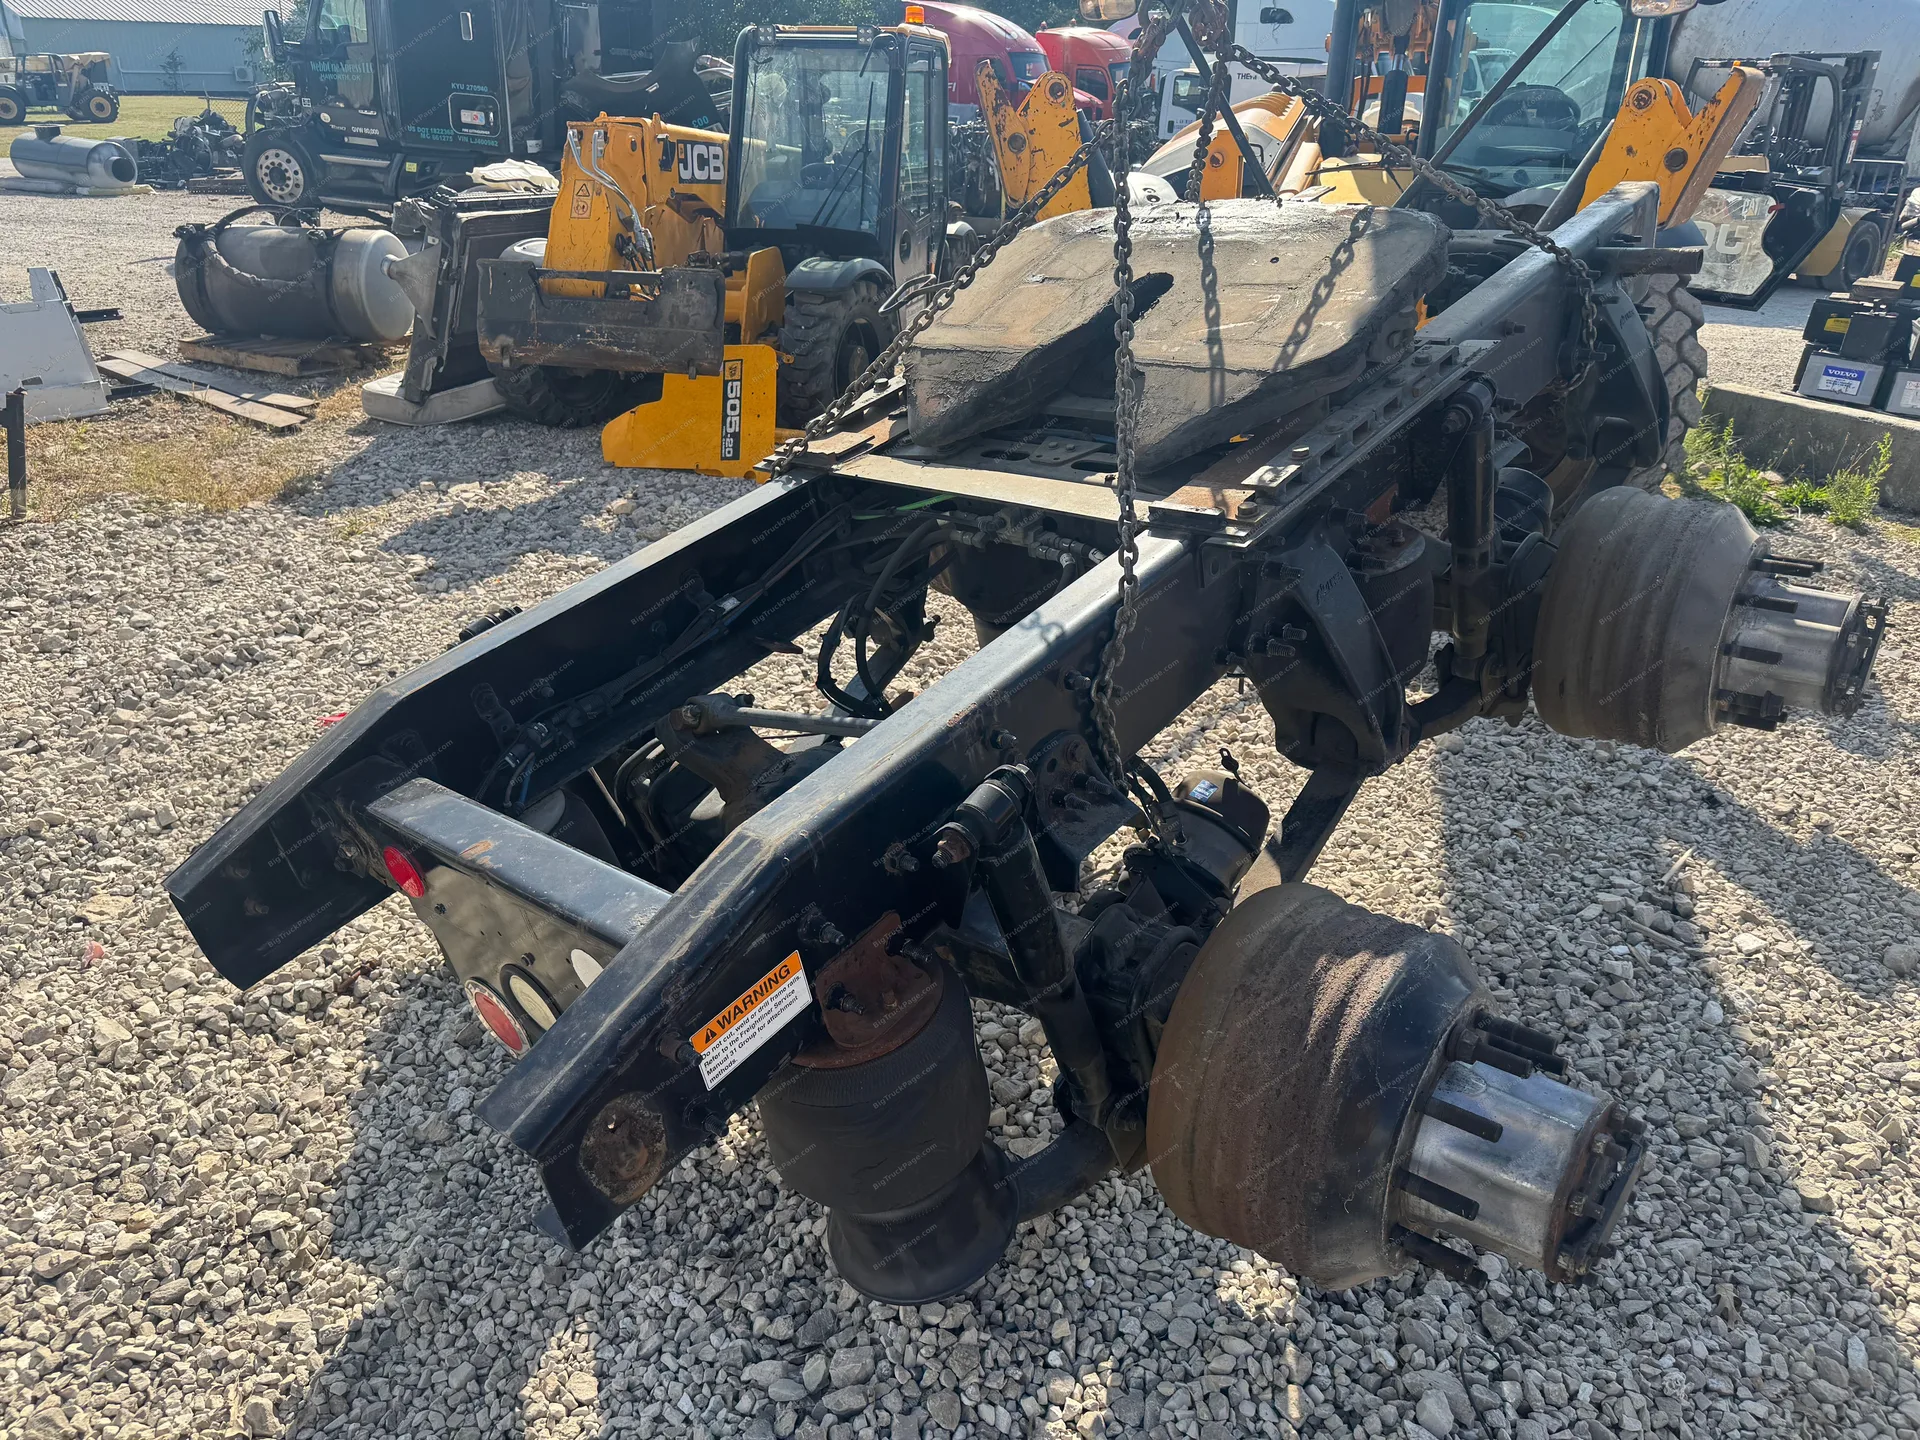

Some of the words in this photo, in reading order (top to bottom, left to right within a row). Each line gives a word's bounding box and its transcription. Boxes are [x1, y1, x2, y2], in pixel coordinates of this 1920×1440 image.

[679, 143, 725, 180] JCB
[1827, 368, 1858, 379] VOLVO
[725, 381, 741, 458] 505-20
[702, 1052, 711, 1061] Do
[711, 1040, 722, 1053] not
[723, 1031, 736, 1043] cut,
[735, 1019, 750, 1033] weld
[750, 1011, 758, 1020] or
[758, 1001, 770, 1013] drill
[769, 987, 787, 1003] frame
[787, 975, 802, 989] rails.
[703, 1050, 721, 1069] Refer
[721, 1046, 729, 1055] to
[729, 1037, 740, 1048] the
[740, 1008, 774, 1039] Freightliner
[773, 988, 796, 1010] Service
[716, 964, 791, 1030] WARNING
[706, 1054, 730, 1076] Manual
[729, 1048, 738, 1057] 31
[738, 1032, 757, 1049] Group
[757, 1023, 767, 1033] for
[766, 996, 799, 1025] attachment
[709, 1058, 739, 1084] methods.
